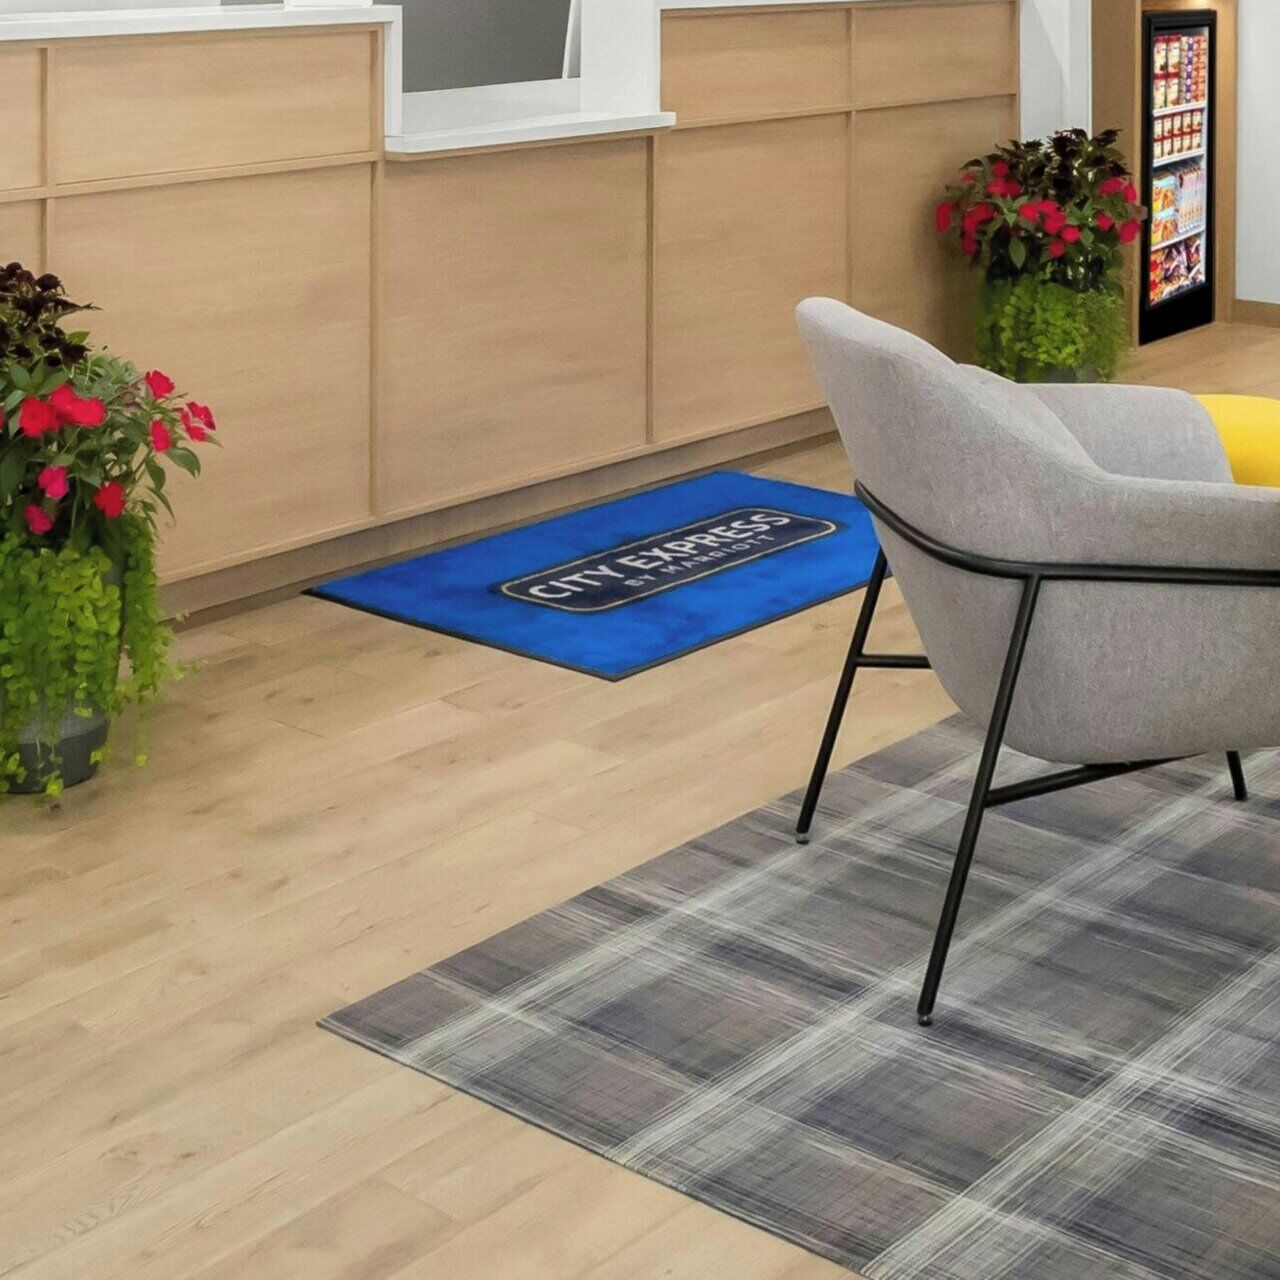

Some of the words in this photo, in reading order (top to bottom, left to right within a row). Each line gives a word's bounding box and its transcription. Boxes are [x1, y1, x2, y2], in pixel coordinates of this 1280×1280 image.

[528, 564, 625, 599] CITY
[615, 513, 791, 570] EXPRESS
[622, 573, 657, 588] BY
[659, 533, 775, 575] MARRIOTT
